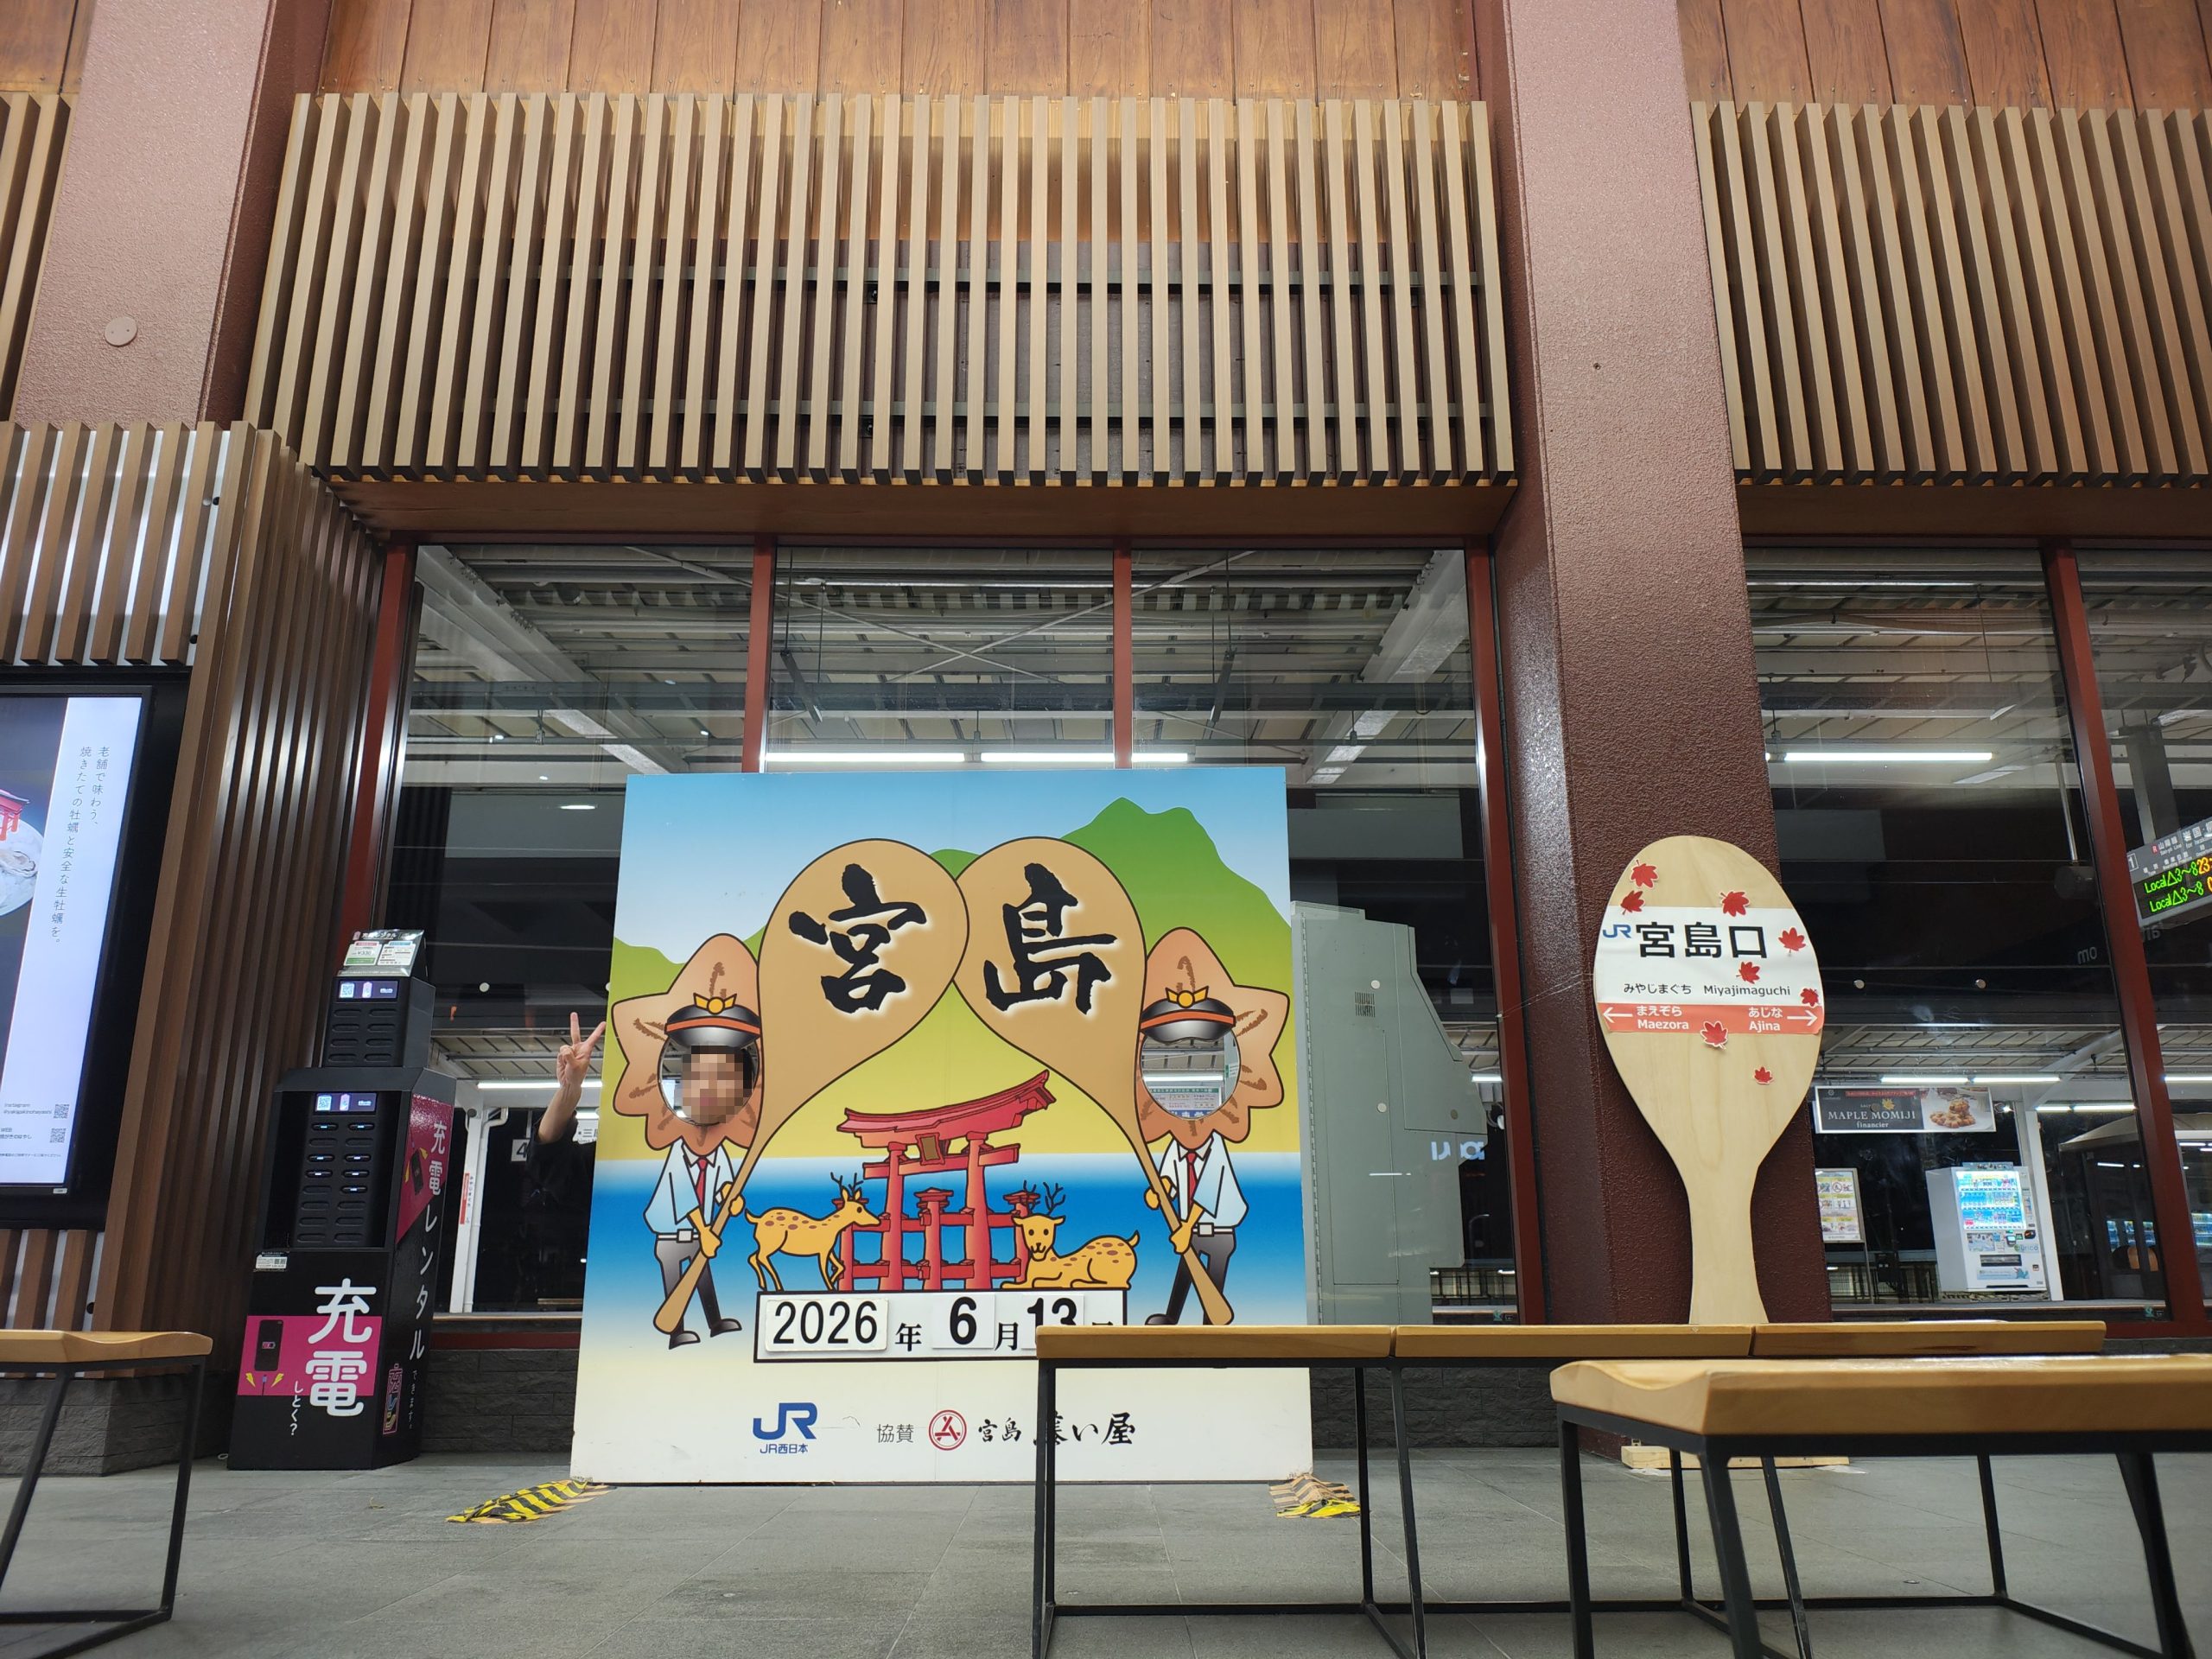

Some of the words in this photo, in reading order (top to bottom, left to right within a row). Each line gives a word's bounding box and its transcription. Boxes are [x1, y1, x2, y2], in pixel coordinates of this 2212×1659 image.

[1602, 924, 1631, 938] JR
[1636, 921, 1767, 958] 宮島口
[1624, 983, 1692, 995] みやじまぐち
[1704, 984, 1790, 997] Miyajimaguchi
[1637, 1006, 1682, 1016] まえぞら
[1749, 1007, 1783, 1018] あじな
[1637, 1019, 1689, 1030] Maezora
[1749, 1020, 1781, 1032] Ajina
[1828, 1111, 1868, 1120] MAPLE
[1872, 1110, 1916, 1120] MOMIJI
[516, 1142, 527, 1158] 4
[410, 1120, 447, 1360] 充電レンタル
[772, 1300, 878, 1344] 2026
[895, 1322, 922, 1351] 年
[950, 1297, 977, 1344] 6
[995, 1322, 1019, 1351] 月
[305, 1278, 377, 1416] 充電
[753, 1402, 818, 1440] JR
[876, 1423, 914, 1443] 協賛
[977, 1416, 1021, 1443] 宮島
[760, 1443, 808, 1455] JR西日本
